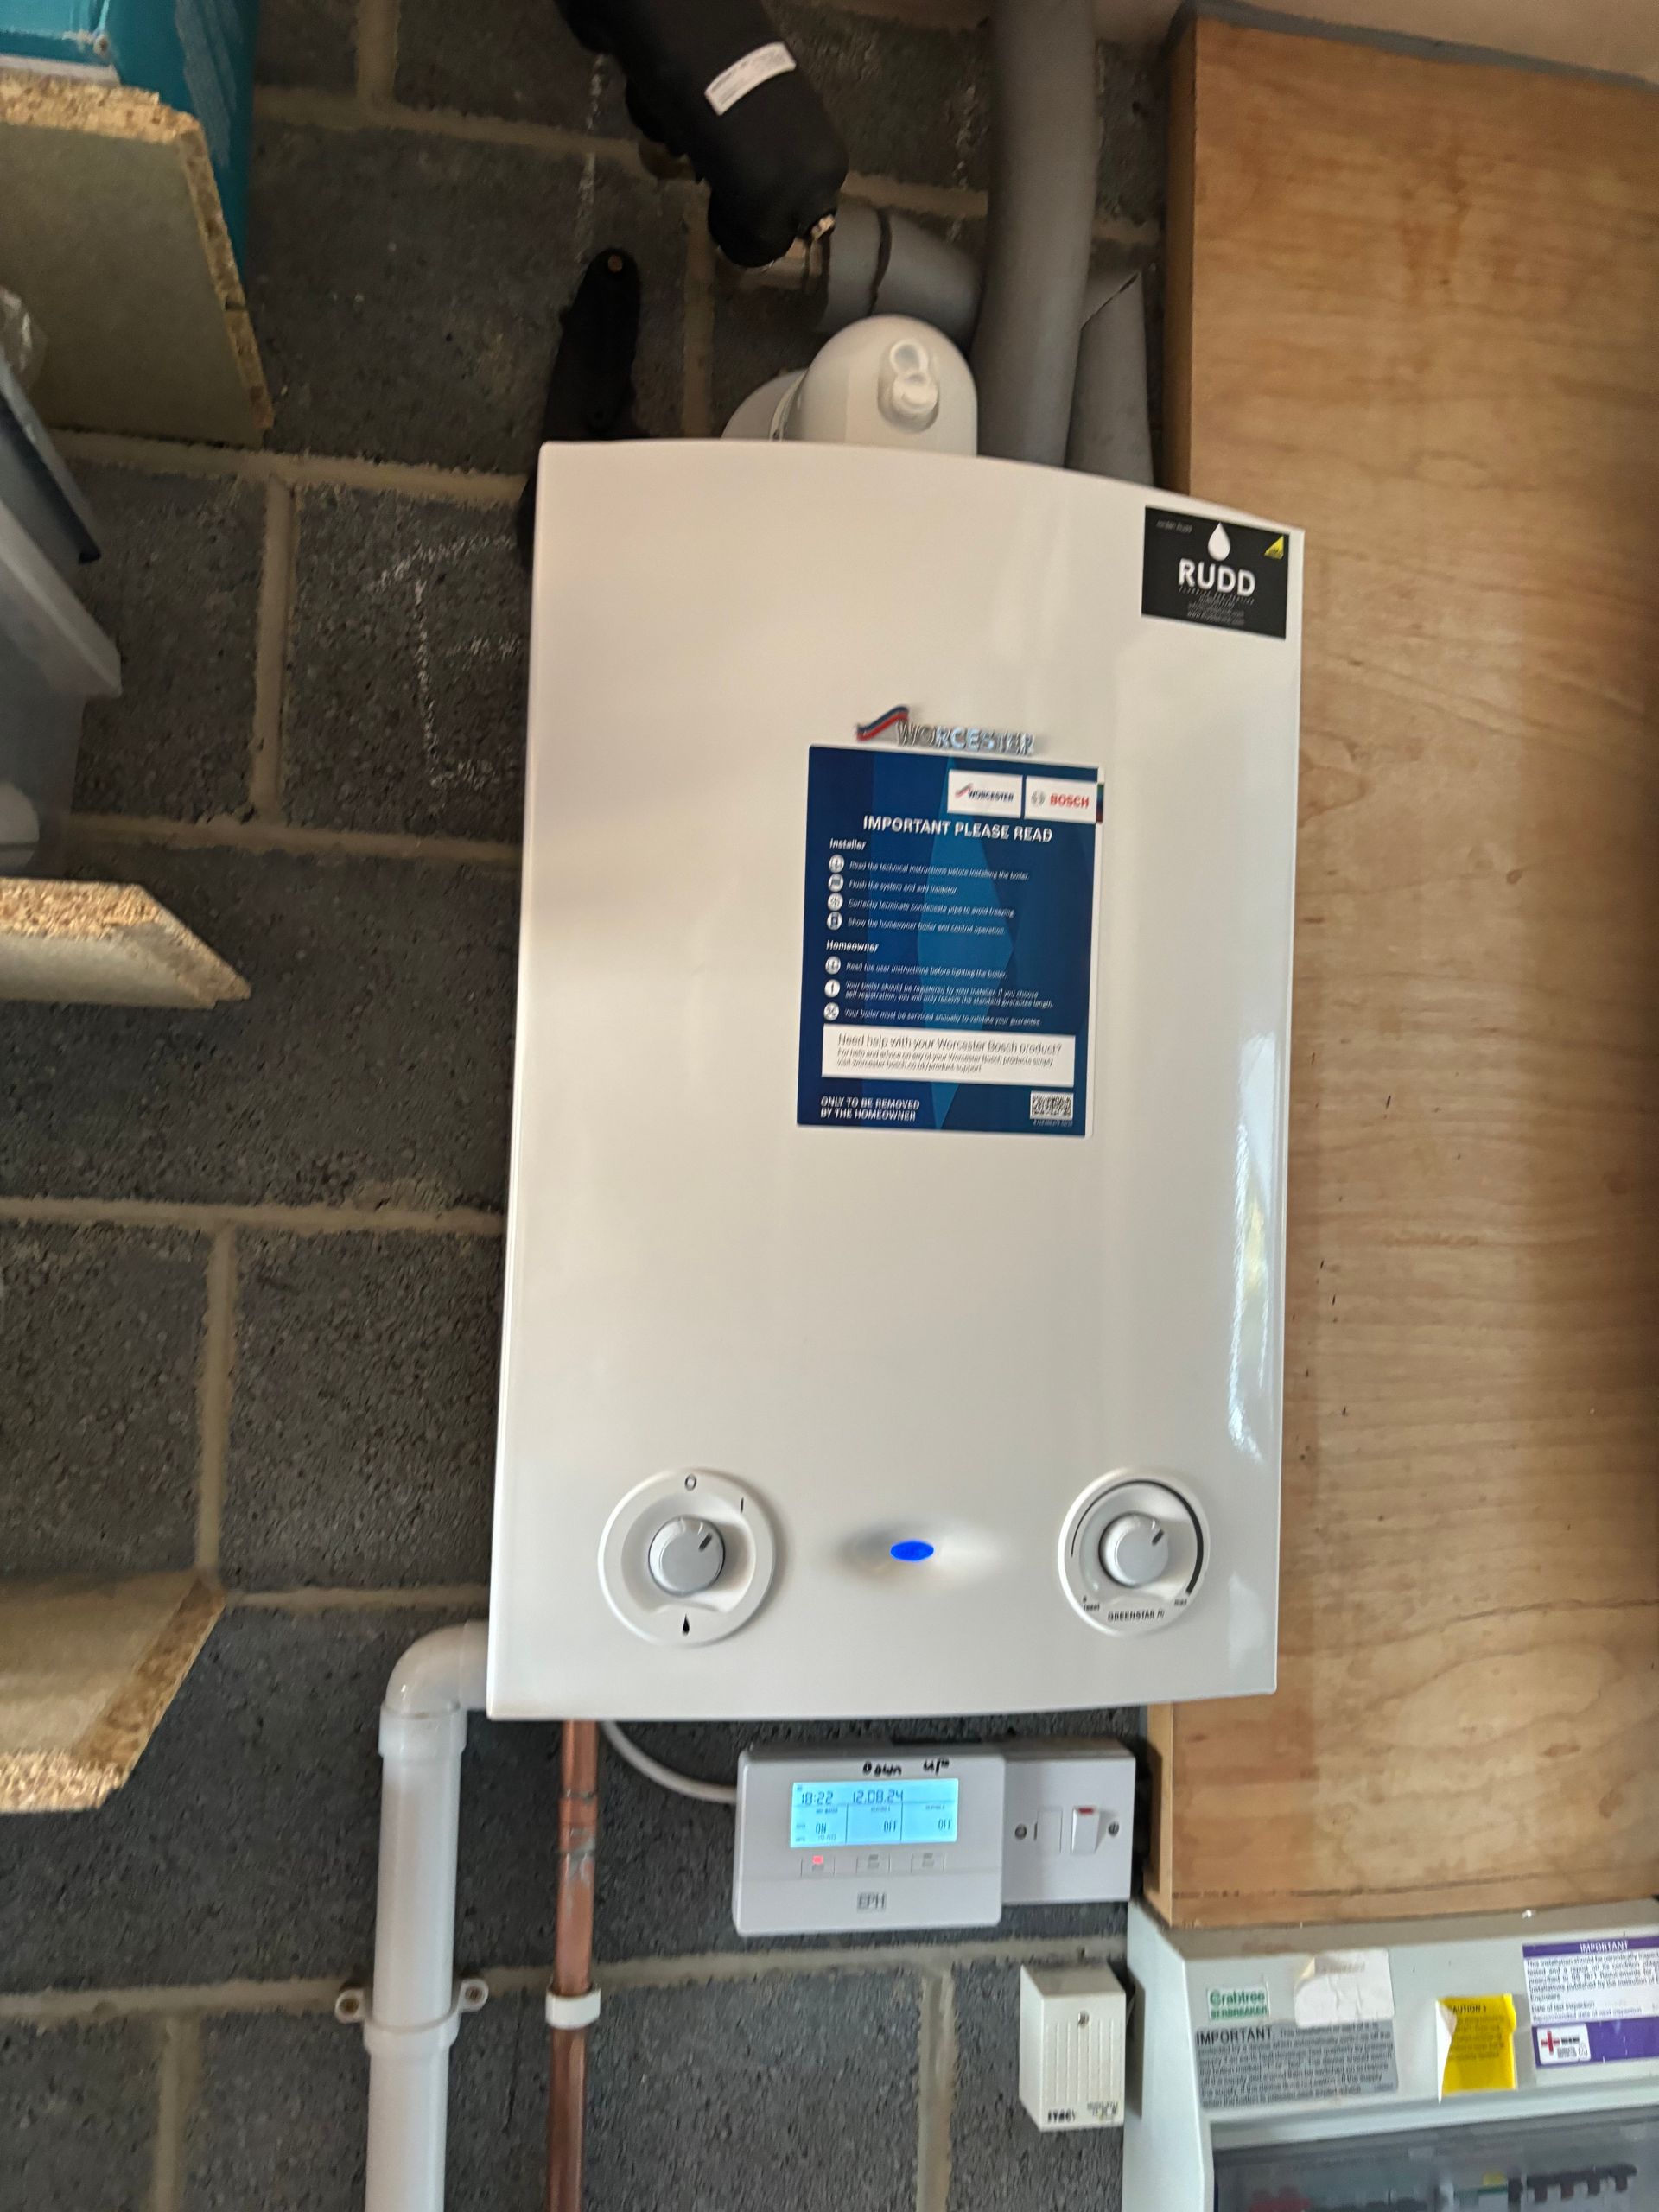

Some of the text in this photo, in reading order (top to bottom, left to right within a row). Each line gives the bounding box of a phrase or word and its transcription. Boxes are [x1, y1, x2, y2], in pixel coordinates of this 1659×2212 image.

[1179, 557, 1256, 597] RUDD
[898, 721, 1036, 756] WORCESTER
[968, 789, 1014, 803] WORCESTER
[1050, 794, 1090, 809] BOSCH
[863, 815, 1052, 842] IMPORTANT PLEASE READ
[830, 838, 867, 850] Installer
[826, 940, 880, 953] Homeowner
[838, 1033, 1062, 1058] Need help with your Worcester Bosch product?
[821, 1096, 920, 1111] ONLY TO BE REMOVED
[821, 1108, 916, 1122] BY THE HOMEOWNER
[1108, 1610, 1155, 1622] GREENSTAR
[862, 1760, 902, 1777] Down
[852, 1789, 904, 1807] 12.08.24
[816, 1822, 827, 1834] ON
[857, 1892, 887, 1910] EPH
[1580, 1940, 1628, 1953] IMPORTANT
[1210, 1989, 1265, 2006] Crabtree
[1196, 2025, 1271, 2046] IMPORTANT
